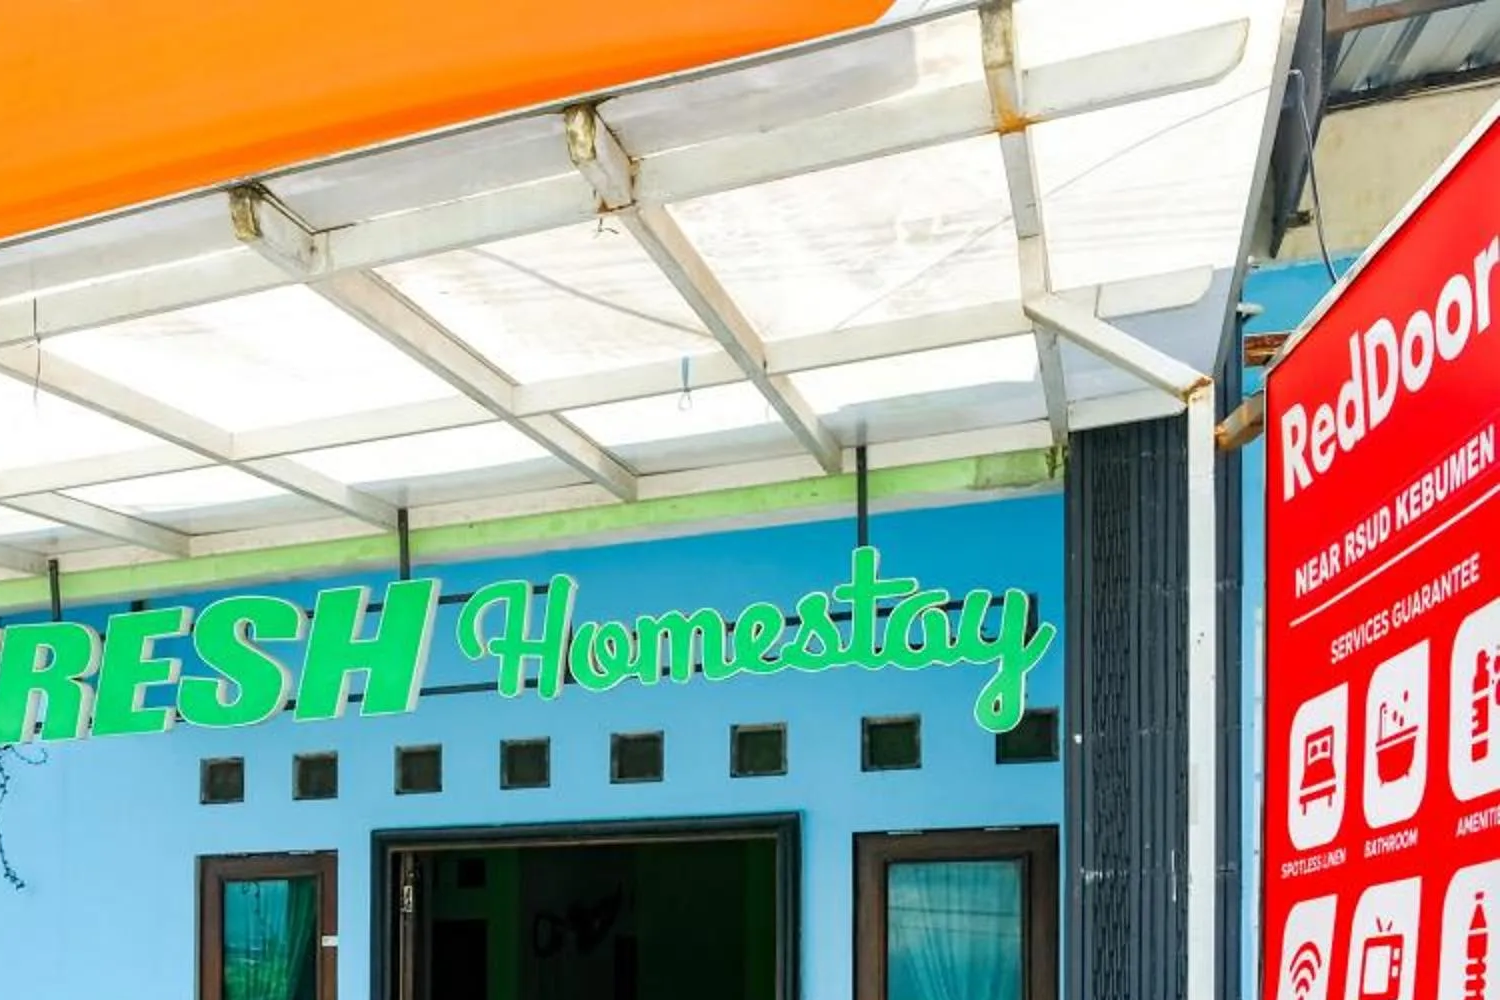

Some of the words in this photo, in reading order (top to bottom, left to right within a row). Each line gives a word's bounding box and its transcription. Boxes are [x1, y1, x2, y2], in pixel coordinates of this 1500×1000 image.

[1295, 543, 1341, 599] NEAR
[1344, 505, 1391, 567] RSUD
[1395, 423, 1495, 531] KEBUMEN
[456, 545, 1055, 733] Homestay
[1330, 609, 1389, 665] SERVICES
[1392, 551, 1481, 628] GUARANTEE
[1280, 853, 1321, 880] SPOTLESS
[1322, 847, 1347, 869] LINEN
[1363, 827, 1419, 858] BATHROOM
